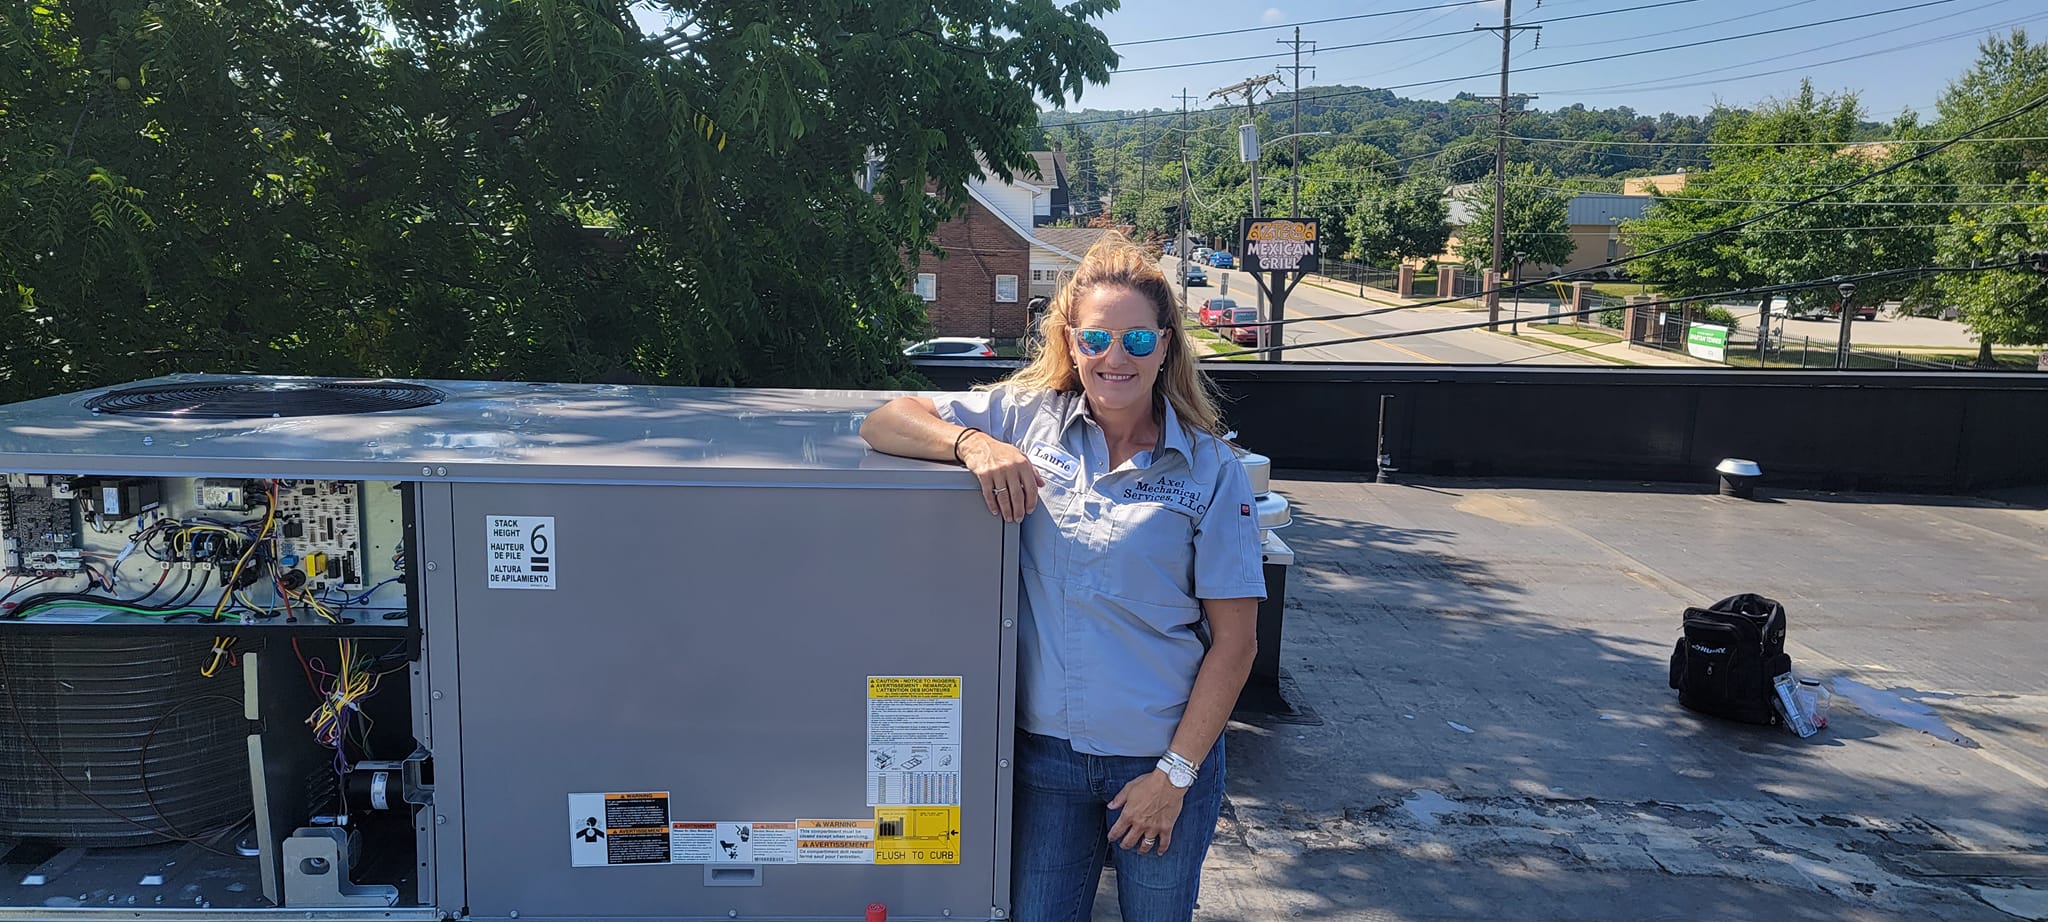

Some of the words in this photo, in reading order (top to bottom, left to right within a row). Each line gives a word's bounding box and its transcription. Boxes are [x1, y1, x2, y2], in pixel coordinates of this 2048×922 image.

[1246, 221, 1317, 241] AZTECA
[1247, 242, 1315, 256] MEXICAN
[1259, 257, 1300, 270] GRILL
[1034, 447, 1071, 472] Laurie
[1157, 476, 1185, 488] Axel
[1135, 481, 1201, 502] Mechanical
[1177, 496, 1206, 515] LLC
[494, 519, 518, 527] STACK
[493, 529, 520, 537] HEIGHT
[530, 524, 548, 555] 6
[490, 543, 525, 551] HAUTEUR
[494, 552, 504, 560] DE
[505, 552, 521, 560] PILE
[494, 565, 522, 573] ALTURA
[490, 574, 500, 582] DE
[501, 574, 548, 583] APILAMIENTO
[876, 851, 906, 860] FLUSH
[911, 851, 924, 860] TO
[929, 851, 954, 860] CURB
